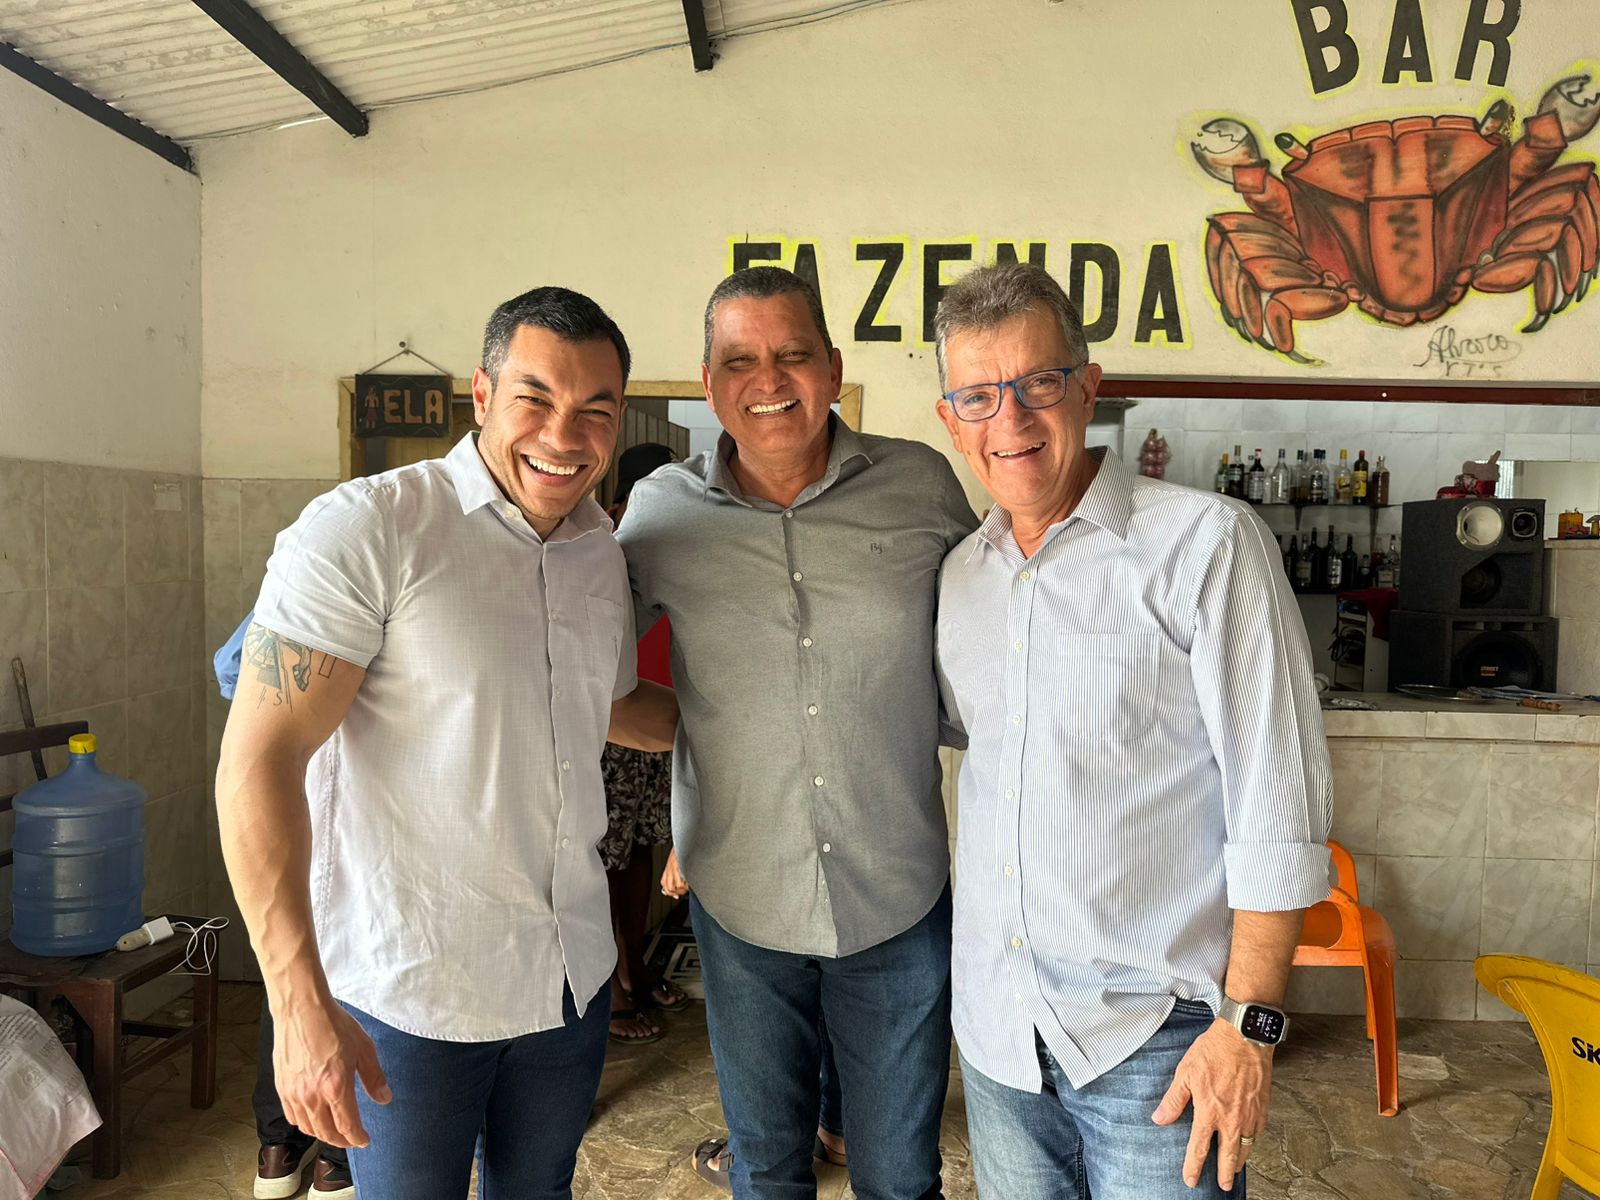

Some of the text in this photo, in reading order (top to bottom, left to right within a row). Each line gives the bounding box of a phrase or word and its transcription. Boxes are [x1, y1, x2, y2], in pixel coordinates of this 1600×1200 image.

[1290, 0, 1522, 95] BAR
[733, 242, 1184, 343] ZEDA
[383, 389, 444, 425] ELA
